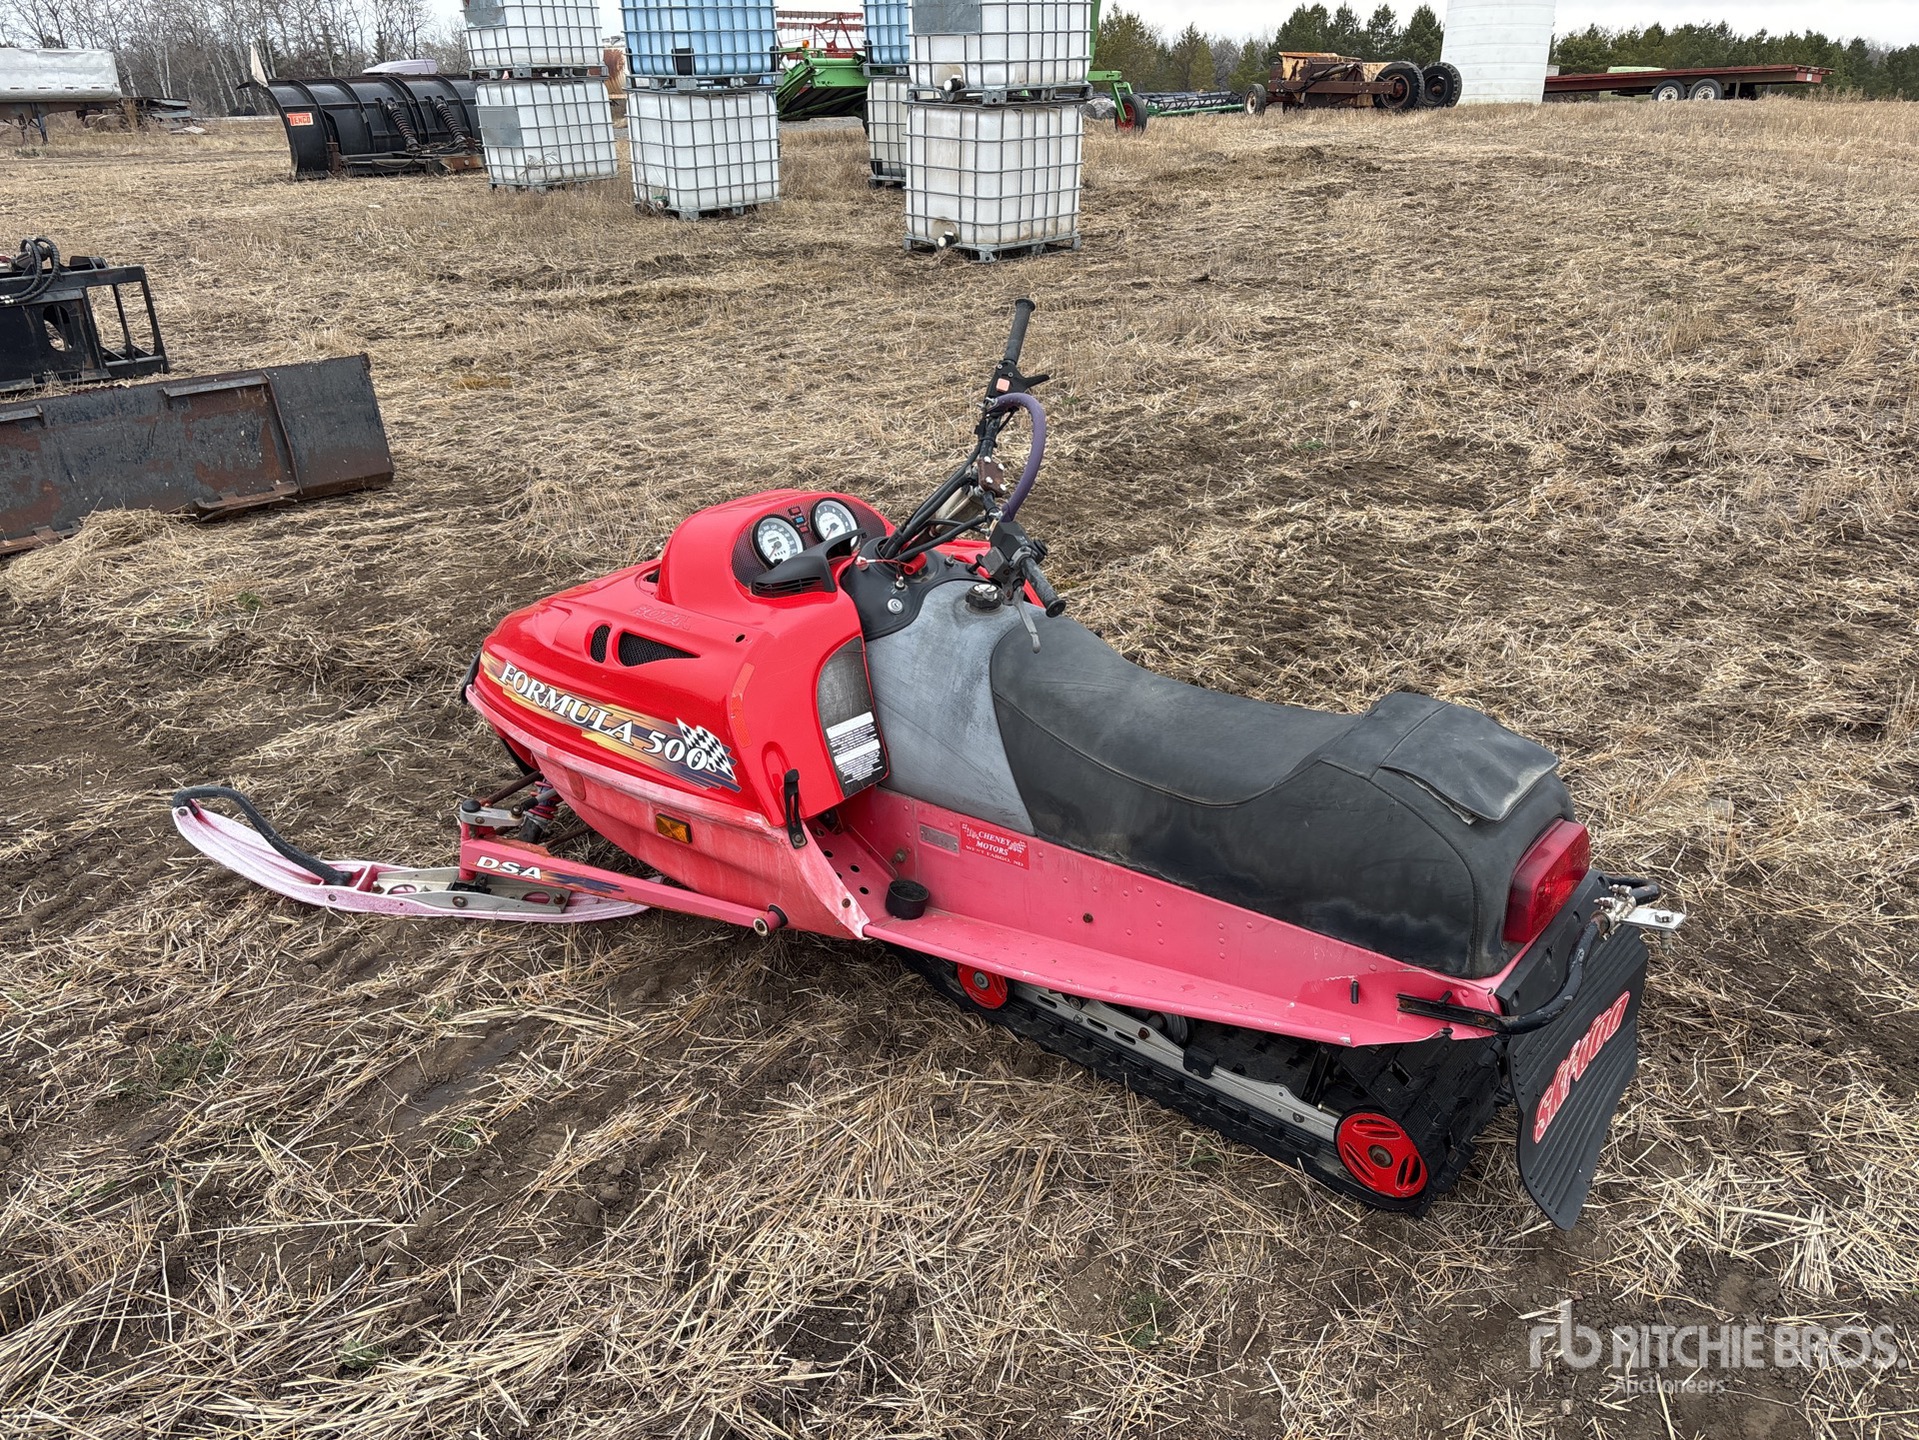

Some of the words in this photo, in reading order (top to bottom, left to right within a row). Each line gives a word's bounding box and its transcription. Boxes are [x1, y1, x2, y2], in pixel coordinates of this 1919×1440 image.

[288, 114, 311, 125] TENCO
[498, 660, 635, 746] FORMULA
[643, 731, 710, 771] 500
[978, 831, 1011, 846] CHENEY
[976, 840, 1009, 856] MOTORS
[476, 856, 542, 880] DSA
